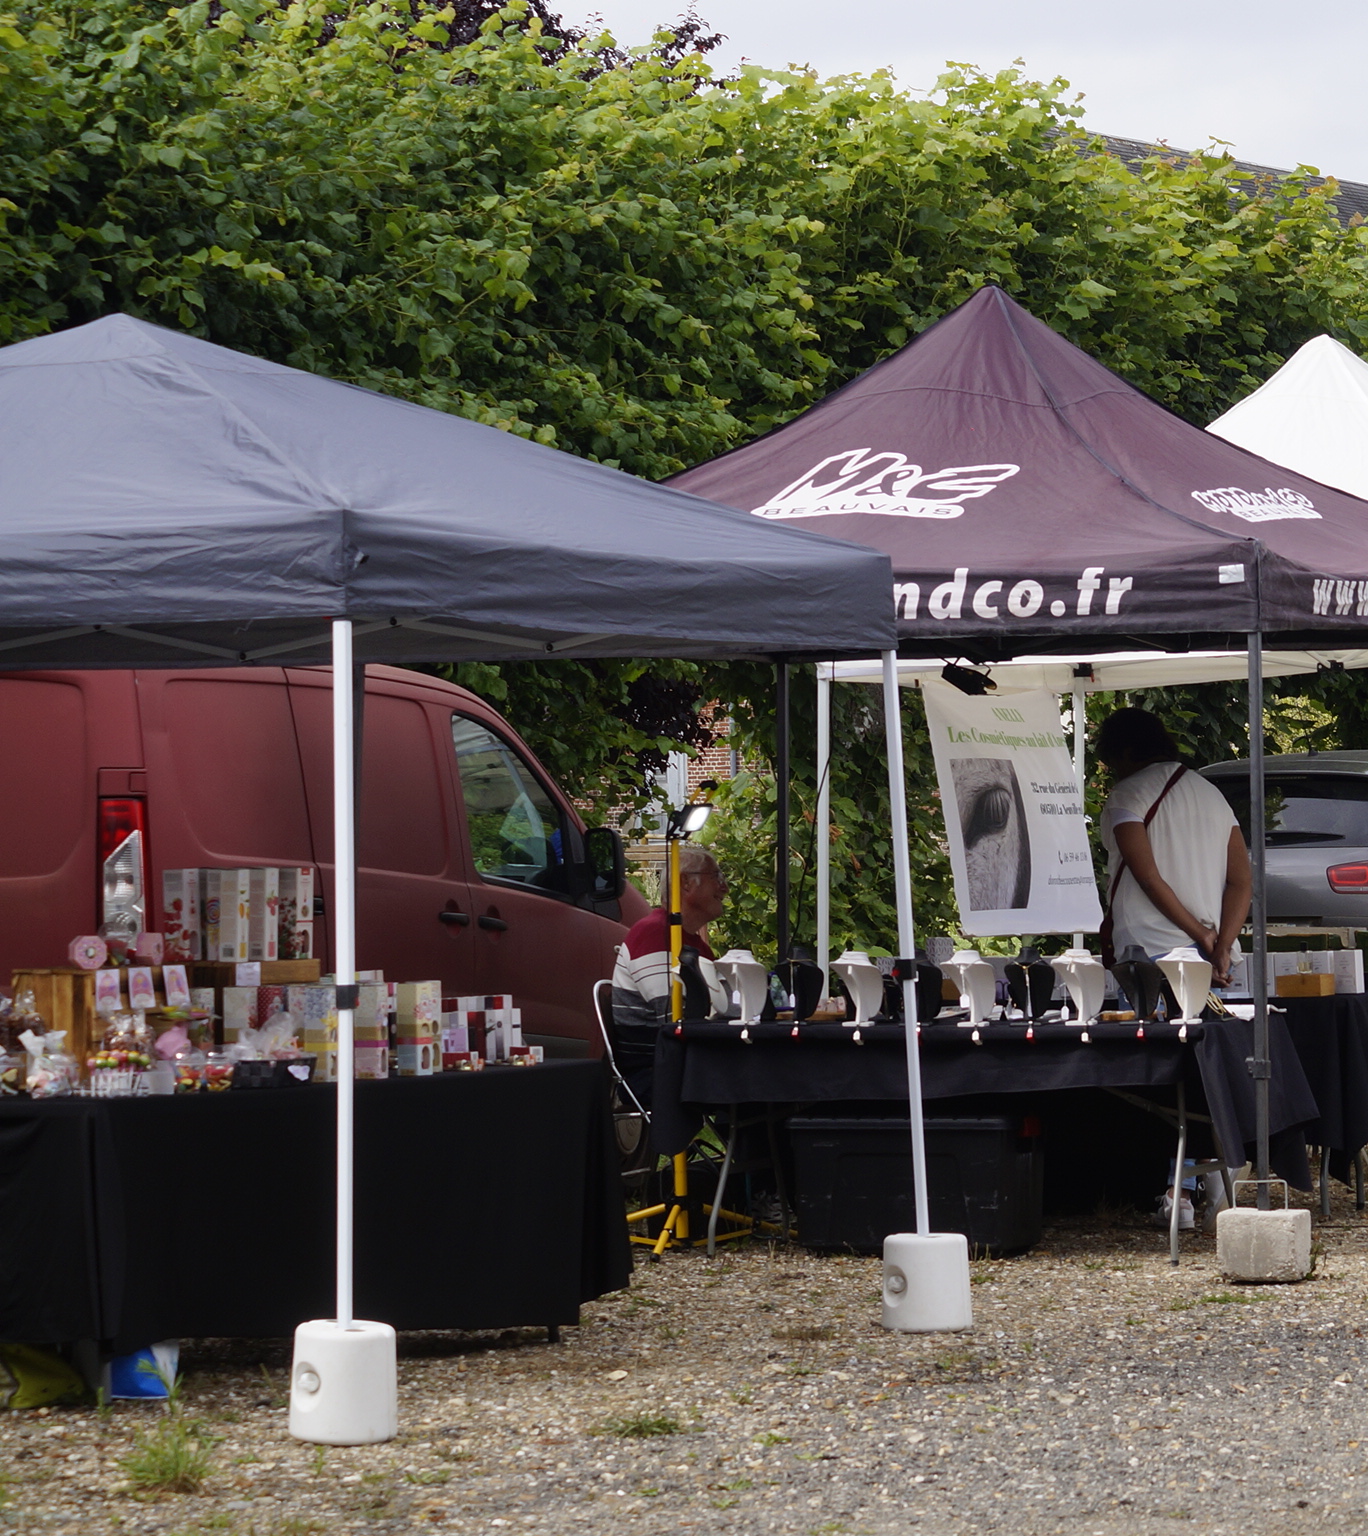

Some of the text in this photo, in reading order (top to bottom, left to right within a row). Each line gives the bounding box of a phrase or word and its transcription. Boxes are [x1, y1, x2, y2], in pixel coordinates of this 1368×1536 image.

[762, 503, 953, 516] BEAUVAIS
[894, 567, 1133, 620] ndco.fr
[947, 725, 972, 744] Les
